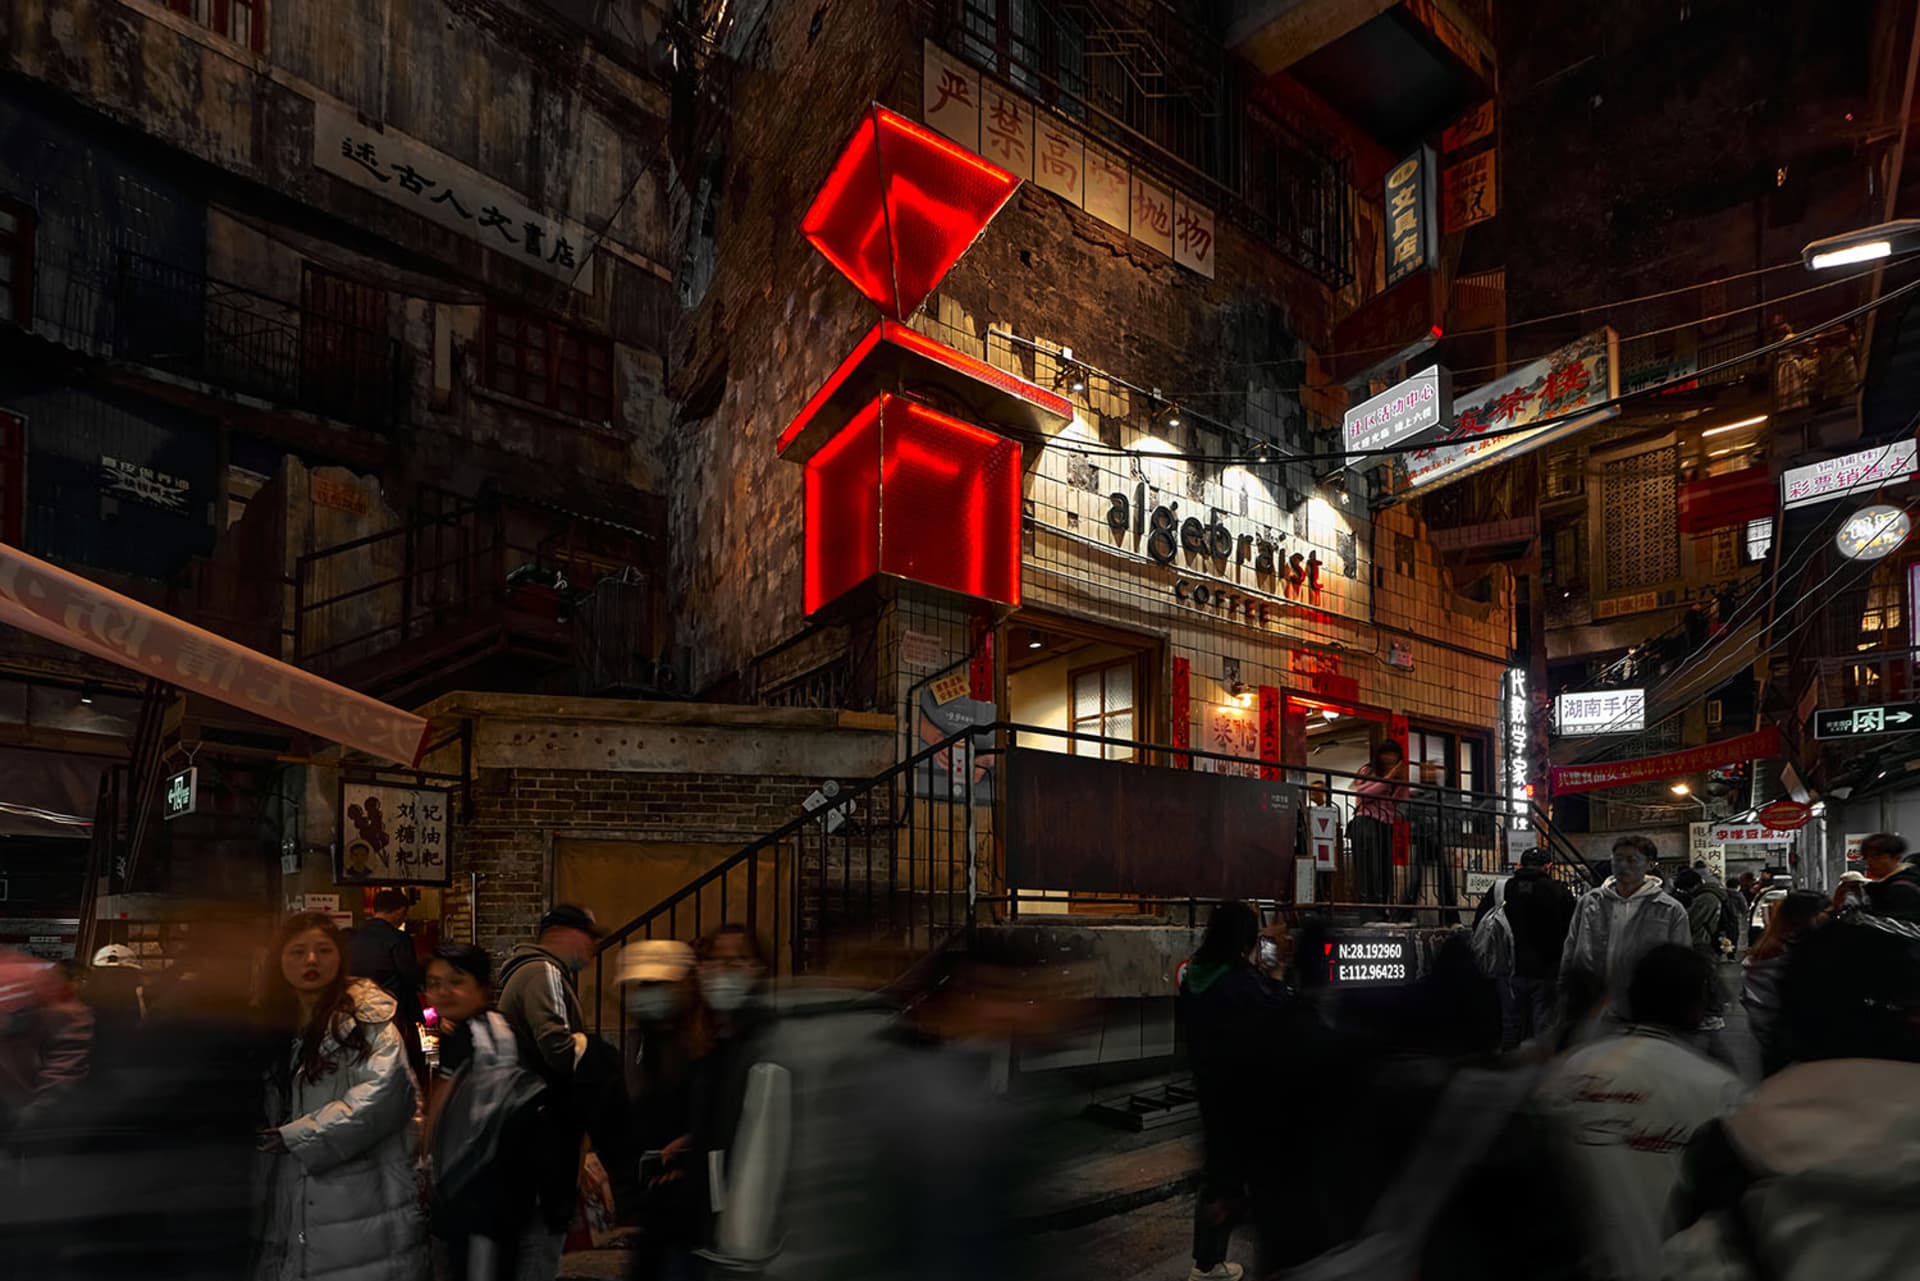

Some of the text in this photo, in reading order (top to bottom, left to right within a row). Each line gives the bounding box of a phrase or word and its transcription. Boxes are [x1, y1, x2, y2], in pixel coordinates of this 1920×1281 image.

[1392, 183, 1418, 266] 文具店
[1350, 384, 1435, 437] 社区活动中心
[1789, 457, 1911, 498] 彩票销售点
[1175, 578, 1270, 623] COFFEE
[1564, 695, 1641, 718] 湖南手信
[1339, 943, 1402, 959] N:28.192960
[1339, 964, 1406, 980] E:112.964233
